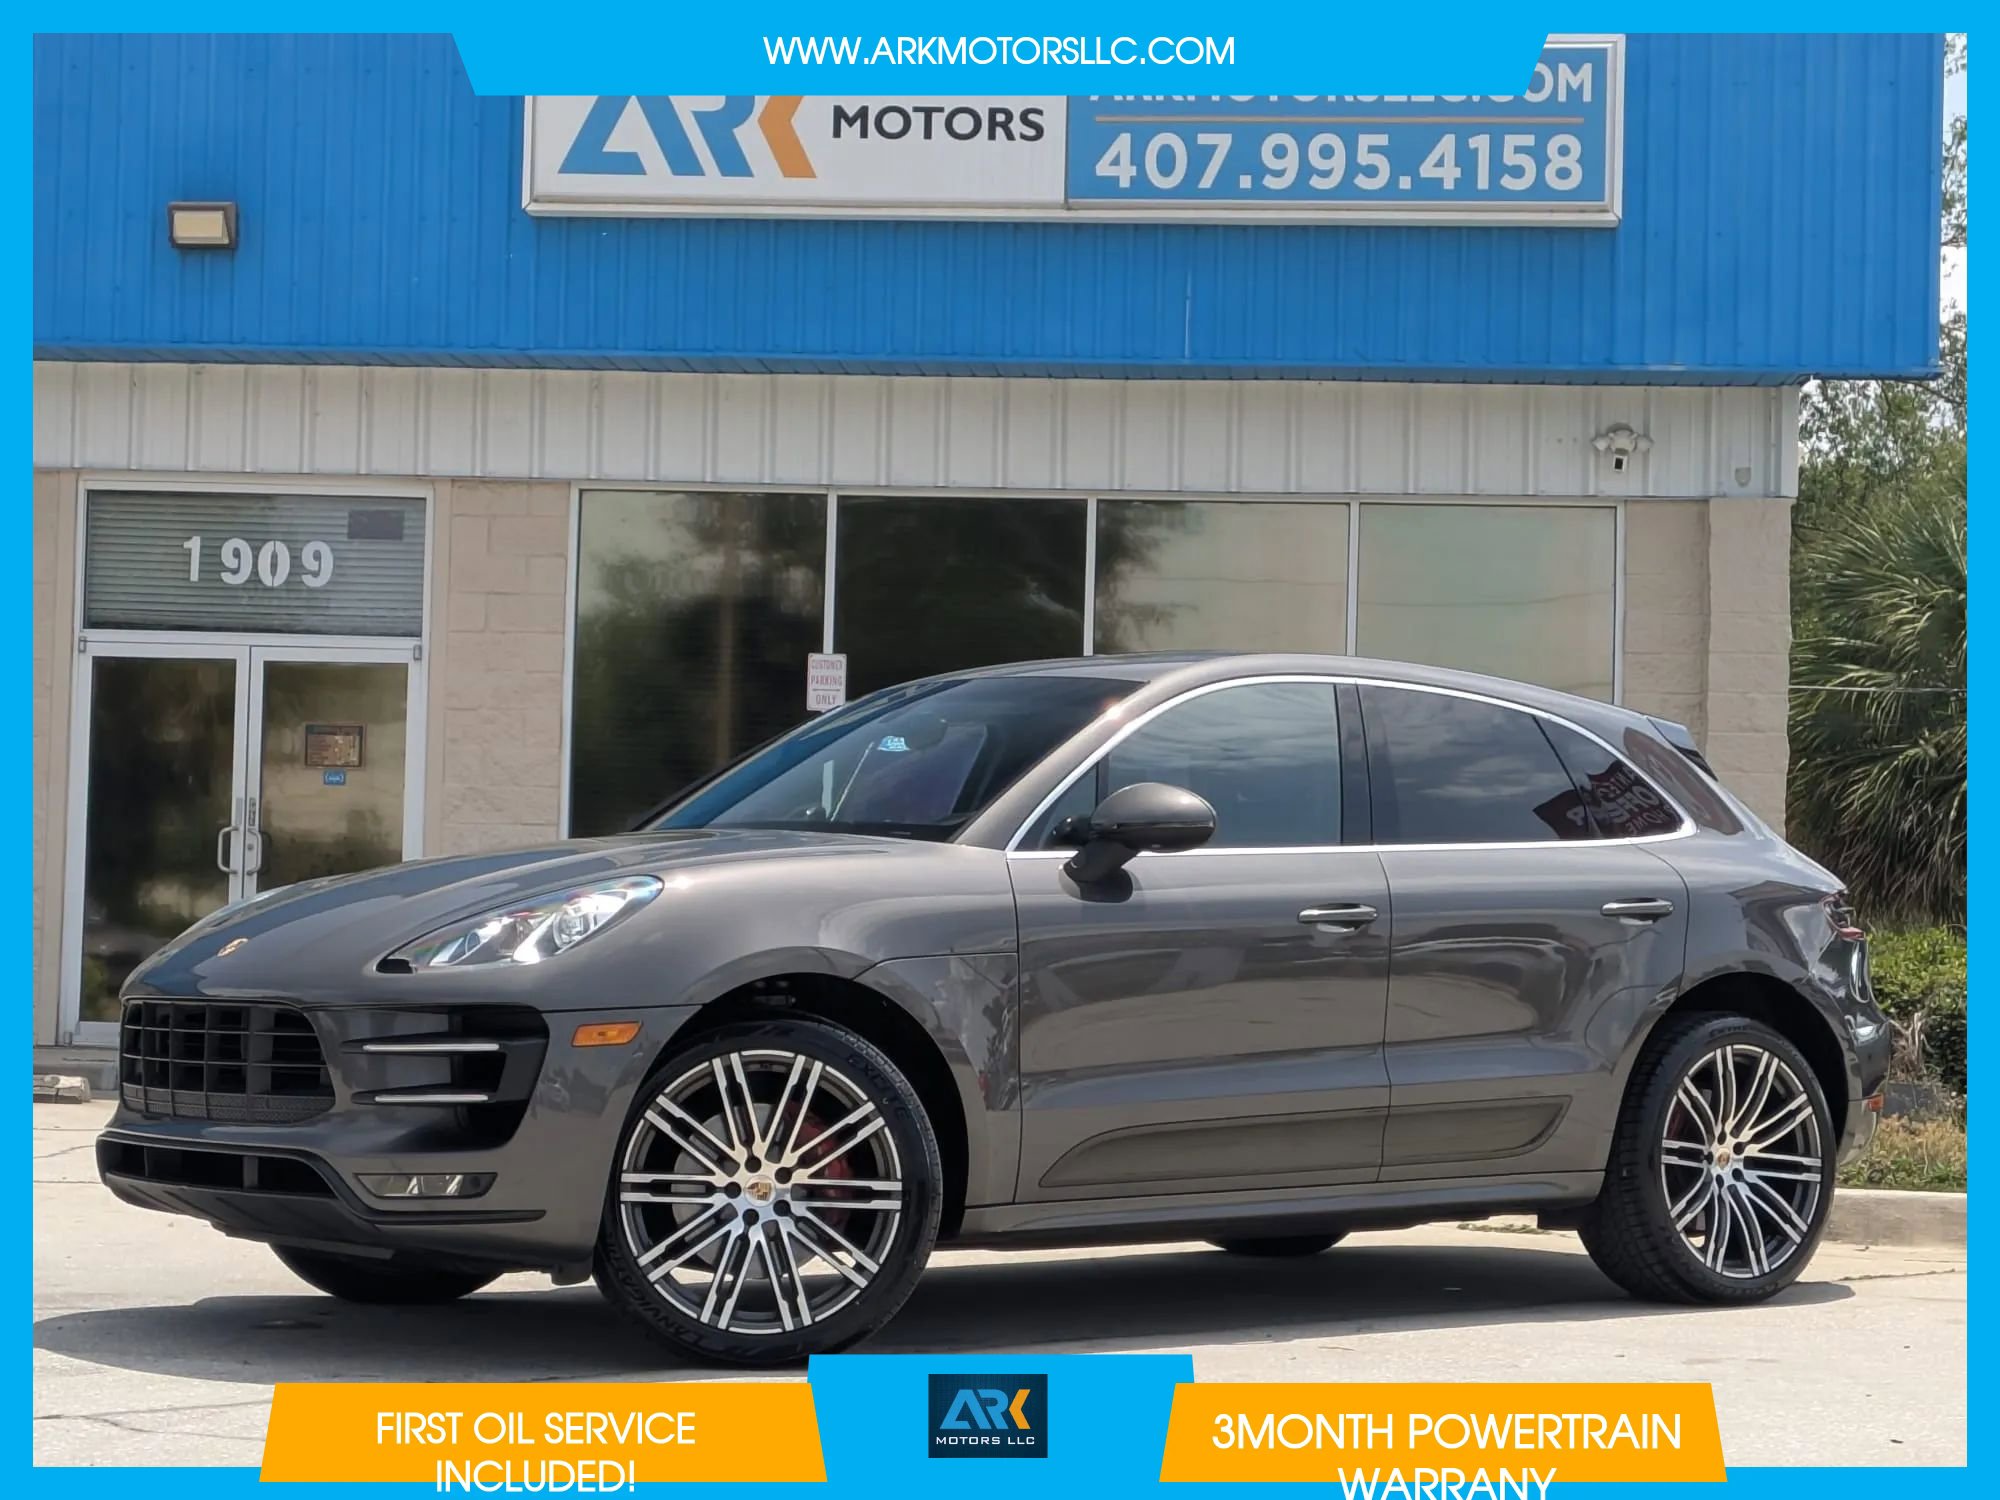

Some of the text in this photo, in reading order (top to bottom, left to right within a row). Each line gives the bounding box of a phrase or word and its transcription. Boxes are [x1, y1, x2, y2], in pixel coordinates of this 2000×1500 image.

[557, 96, 817, 178] ARK
[832, 104, 1045, 142] MOTORS
[1094, 132, 1584, 190] 407.995.4158
[183, 535, 334, 588] 1909
[811, 675, 843, 686] PARKING
[815, 694, 837, 705] ONLY
